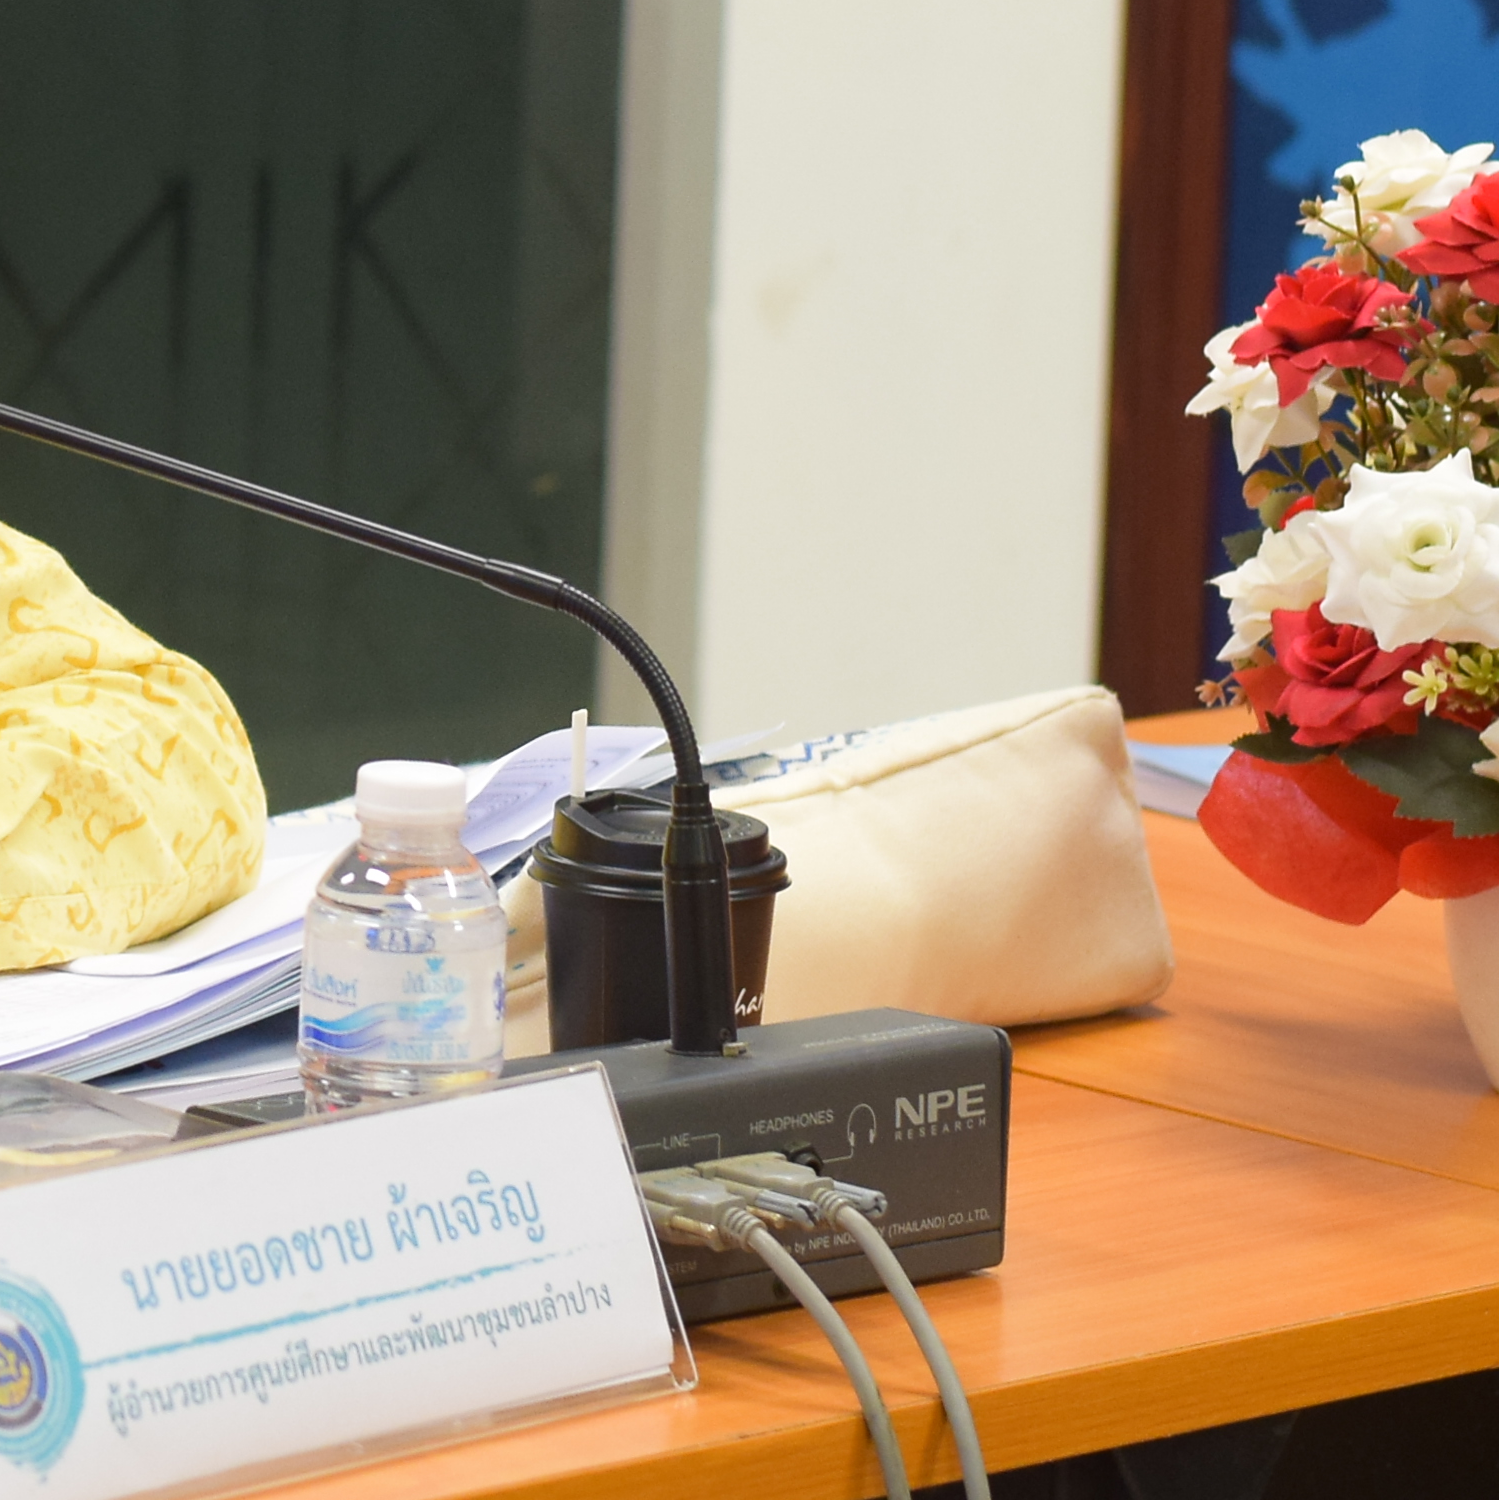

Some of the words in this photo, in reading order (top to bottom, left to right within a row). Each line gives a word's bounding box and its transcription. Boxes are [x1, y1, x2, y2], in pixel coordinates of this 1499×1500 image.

[749, 1109, 835, 1135] HEADPHONES
[895, 1084, 987, 1129] NPE
[662, 1132, 690, 1150] LINE
[894, 1116, 987, 1141] RESEARCH
[122, 1216, 374, 1312] นายยอดชาย
[386, 1169, 547, 1252] ผ้าเจริญ
[808, 1235, 830, 1250] NPE
[888, 1216, 946, 1239] (THAILAND)
[106, 1280, 613, 1440] ผู้อำนวยการศูนย์ศึกษาและพัฒนาชุมชนลำปาง
